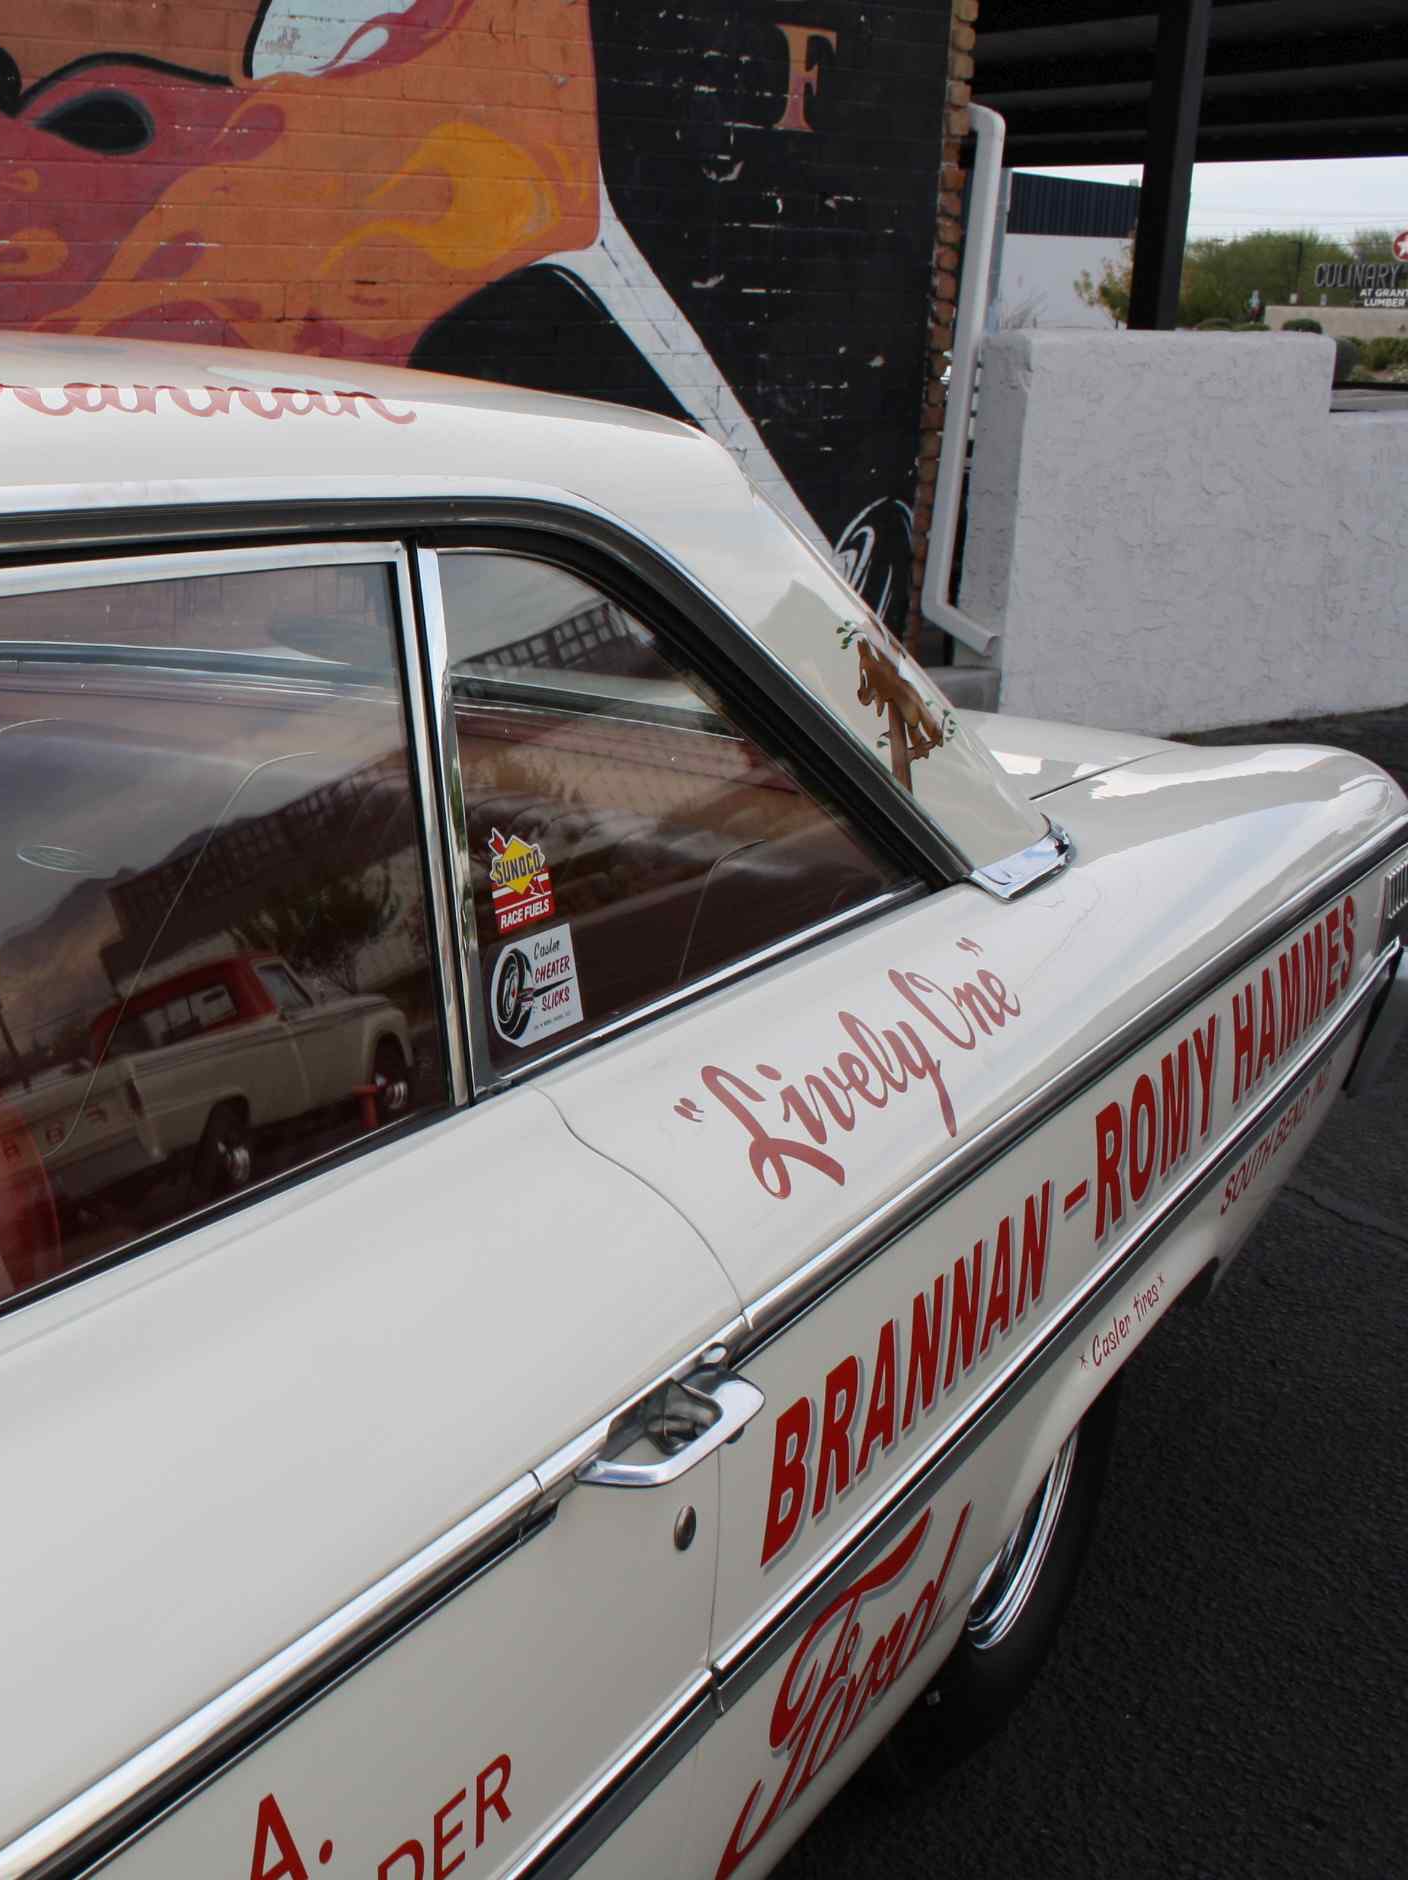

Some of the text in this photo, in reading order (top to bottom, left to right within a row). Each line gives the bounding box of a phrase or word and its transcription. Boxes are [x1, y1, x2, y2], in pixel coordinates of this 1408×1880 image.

[773, 22, 838, 133] F
[1314, 263, 1400, 289] CULINARY
[1363, 298, 1406, 307] LUMBER
[495, 848, 542, 884] SUNOCO
[500, 898, 550, 929] RACE FUELS
[534, 955, 570, 983] CHEATER
[542, 986, 570, 1011] SLICKS
[1232, 895, 1356, 1105] HAMMES
[1092, 1316, 1131, 1367] Casler
[715, 1499, 974, 1880] Ford
